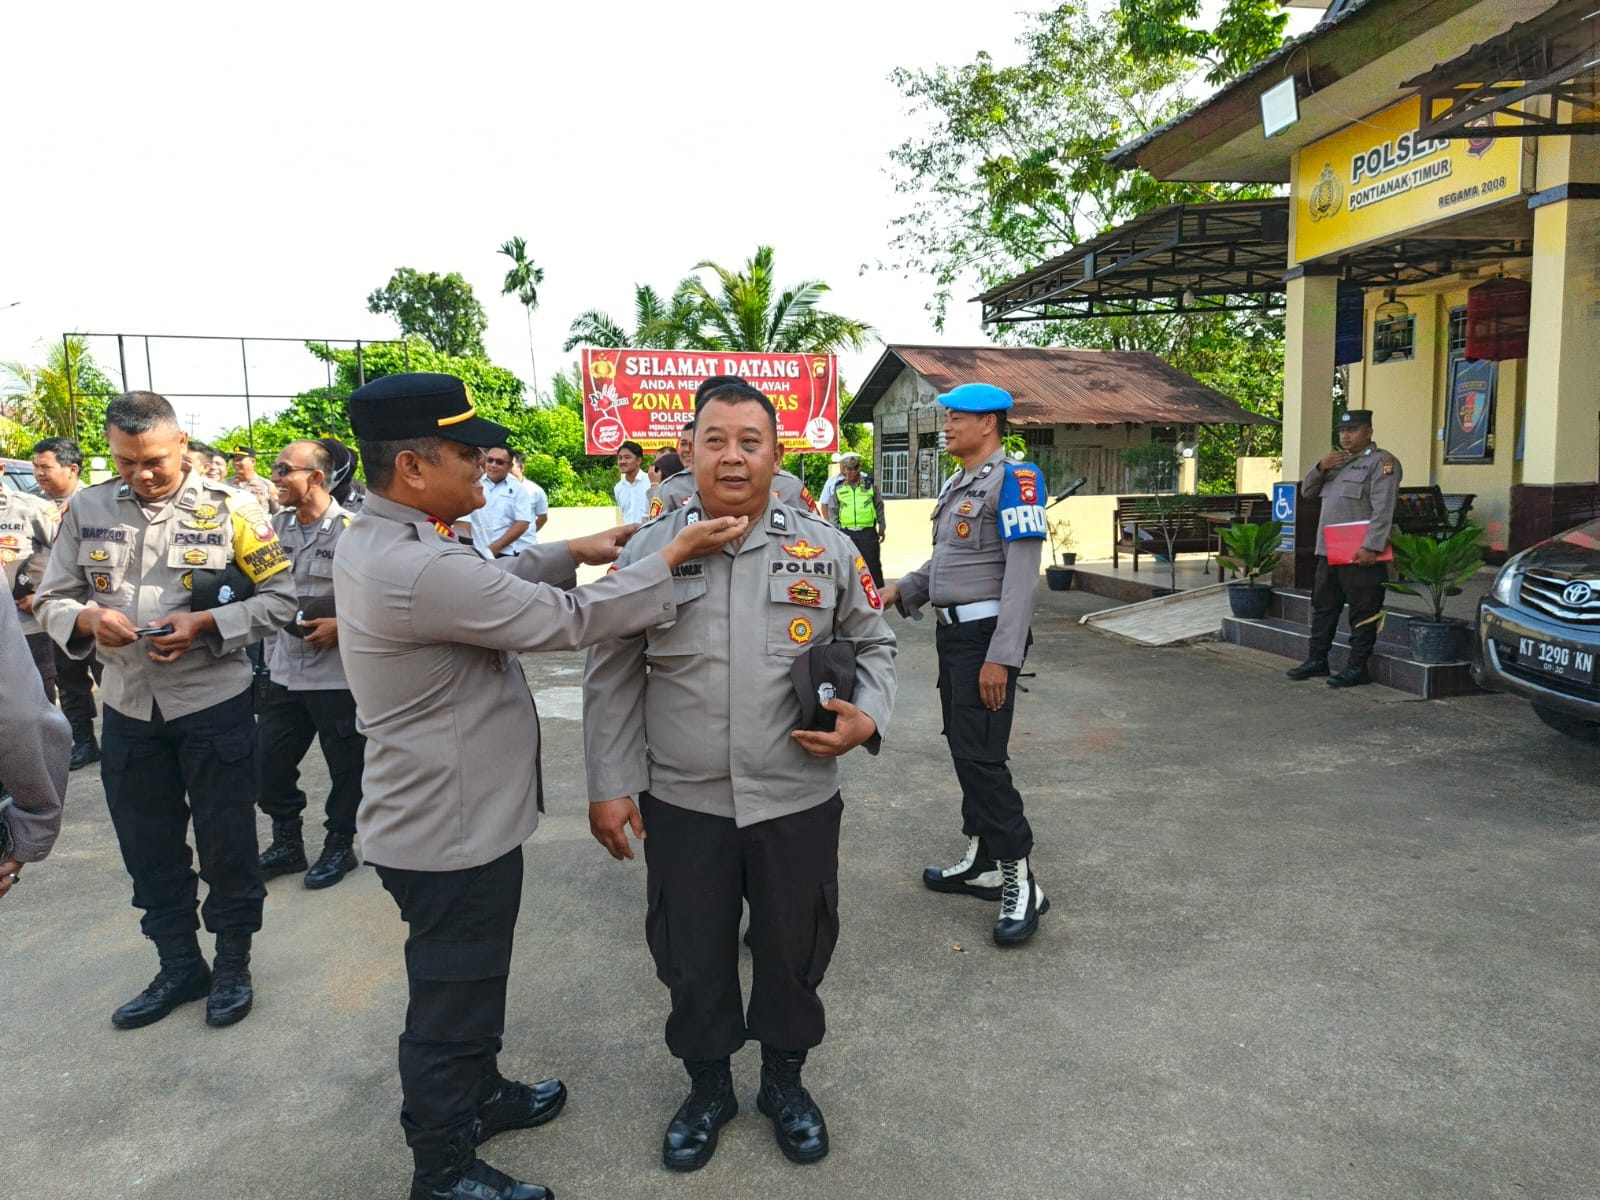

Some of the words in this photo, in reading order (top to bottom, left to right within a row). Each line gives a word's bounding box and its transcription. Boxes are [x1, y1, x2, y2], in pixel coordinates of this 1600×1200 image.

[1349, 177, 1409, 208] PONTIANAK
[1411, 159, 1449, 184] TIMUR
[1438, 186, 1478, 207] REGAMA
[1481, 177, 1505, 194] 2008
[625, 356, 718, 377] SELAMAT
[724, 359, 800, 378] DATANG
[640, 379, 675, 390] ANDA
[632, 392, 685, 410] ZONA
[0, 523, 24, 531] OLRI
[174, 532, 223, 545] POLRI
[316, 549, 335, 560] POL
[772, 561, 833, 576] POLRI
[1519, 637, 1535, 657] KT
[1538, 643, 1569, 666] 1290
[1574, 651, 1593, 673] KN
